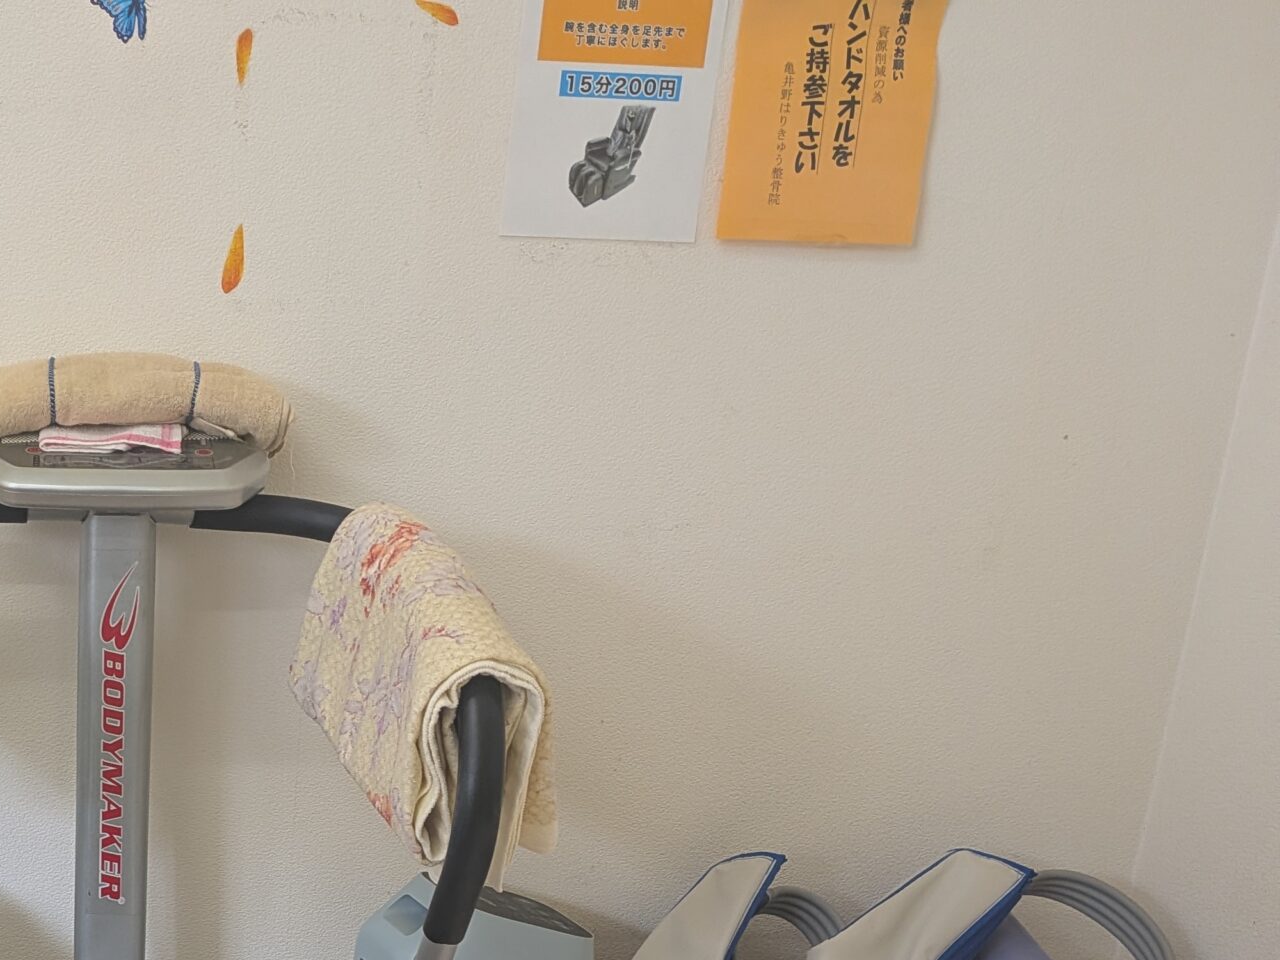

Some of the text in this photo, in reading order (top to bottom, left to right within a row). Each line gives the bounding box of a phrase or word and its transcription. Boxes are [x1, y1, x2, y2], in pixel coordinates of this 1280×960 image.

[564, 21, 686, 38] 腕を含む全身を足先まで
[576, 34, 667, 50] 丁寧にほぐします。
[617, 0, 639, 11] 説明
[566, 75, 677, 99] 15分200円
[794, 23, 834, 174] ご持参下さい
[831, 0, 871, 168] ハンドタオルを
[871, 25, 891, 105] 資源削減の為
[768, 61, 796, 206] 亀井野はりきゅう整骨院
[99, 648, 126, 902] BODYMAKER
